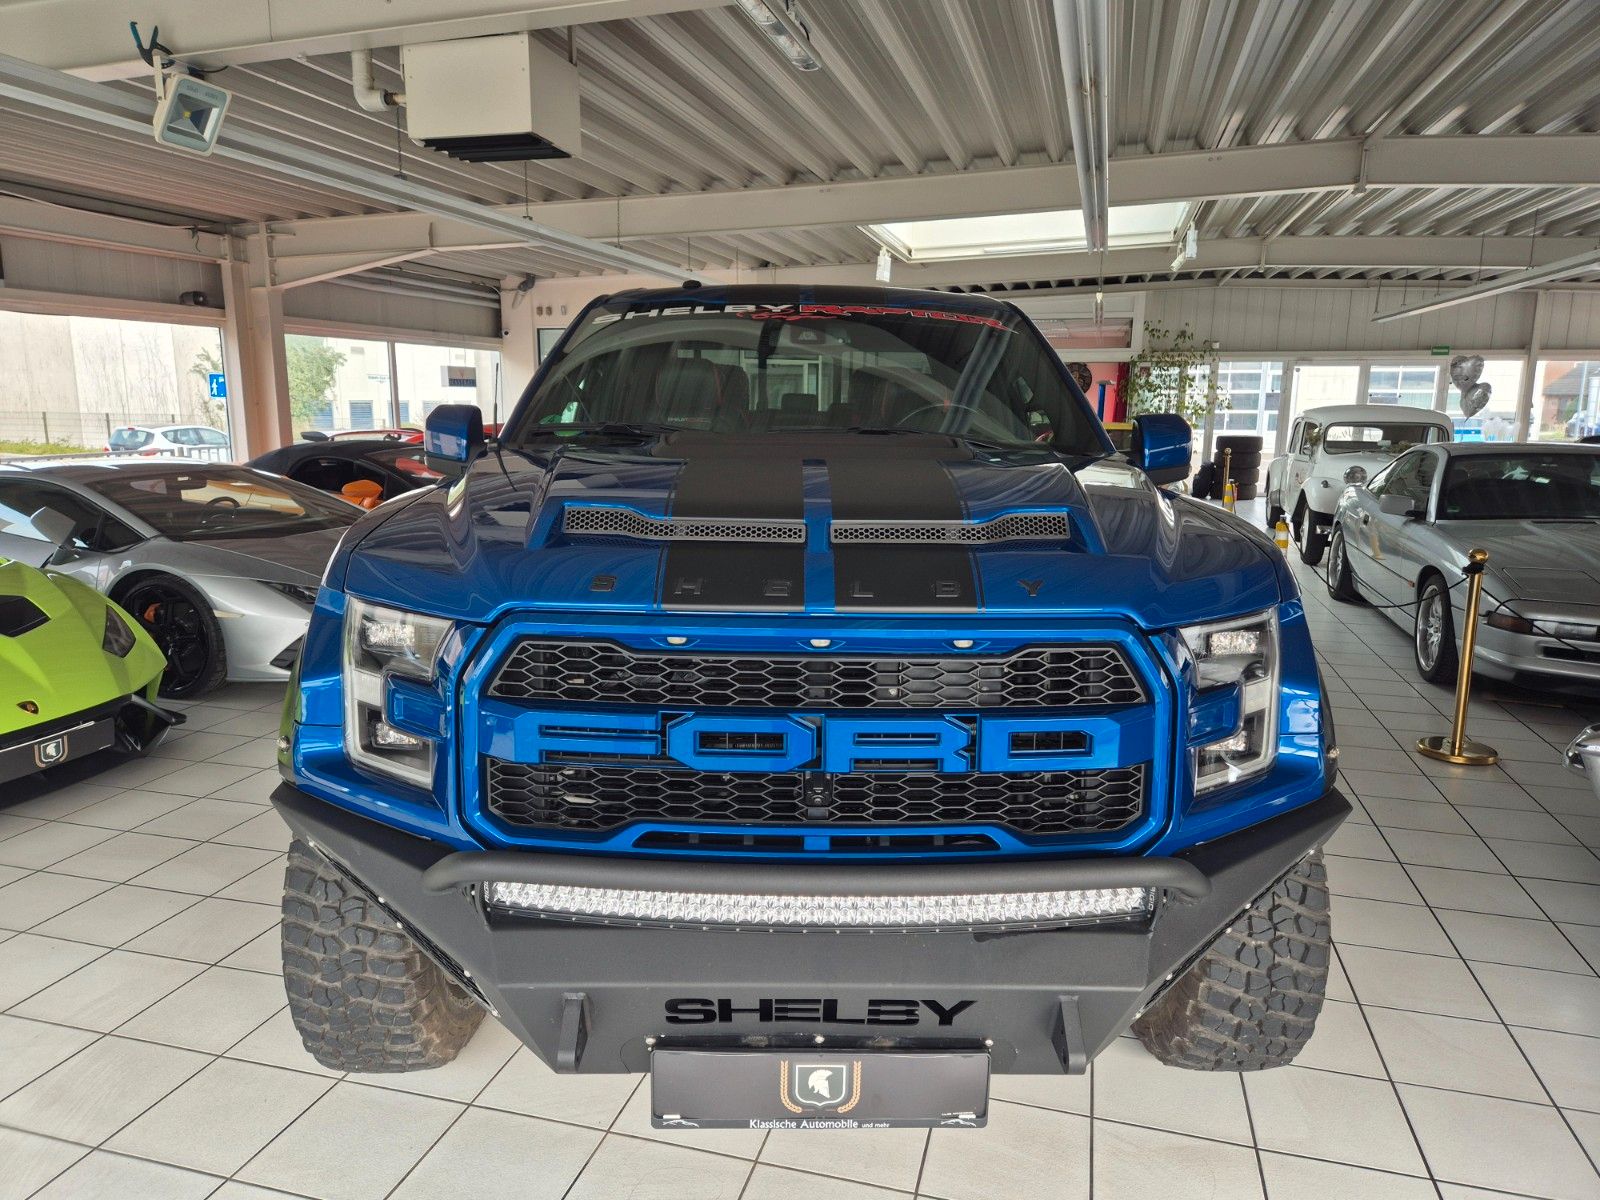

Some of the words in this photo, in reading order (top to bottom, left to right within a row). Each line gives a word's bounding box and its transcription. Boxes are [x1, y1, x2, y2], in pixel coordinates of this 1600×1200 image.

[592, 304, 793, 325] SHELBY
[799, 304, 1017, 333] RAPTOR
[590, 576, 1043, 598] SHELBY
[514, 711, 1121, 773] FORD
[665, 998, 978, 1026] SHELBY
[749, 1119, 797, 1129] Klassische
[800, 1119, 859, 1129] Automobile
